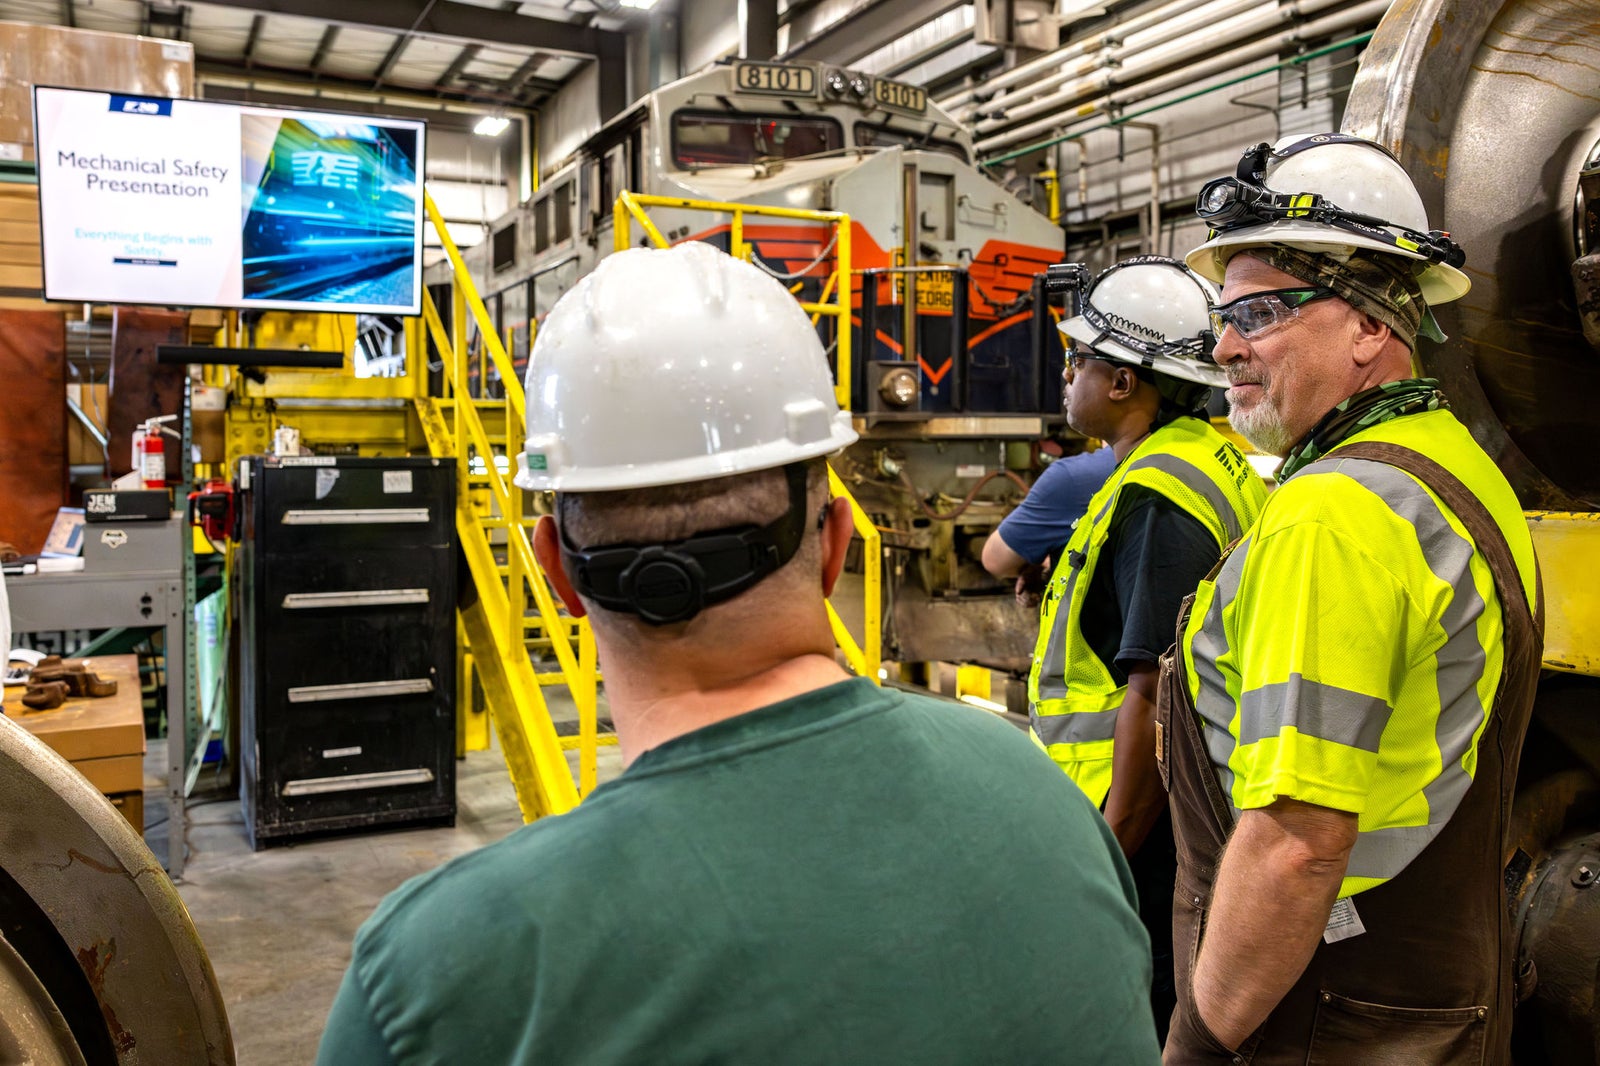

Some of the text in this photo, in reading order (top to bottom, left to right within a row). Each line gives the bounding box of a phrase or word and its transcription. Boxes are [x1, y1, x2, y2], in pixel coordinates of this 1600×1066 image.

[748, 66, 803, 92] 8101
[881, 82, 919, 109] 8101
[57, 150, 229, 183] Mechanical Safety
[86, 173, 209, 197] Presentation
[74, 228, 213, 246] Everything Begins with
[88, 494, 117, 507] JEM
